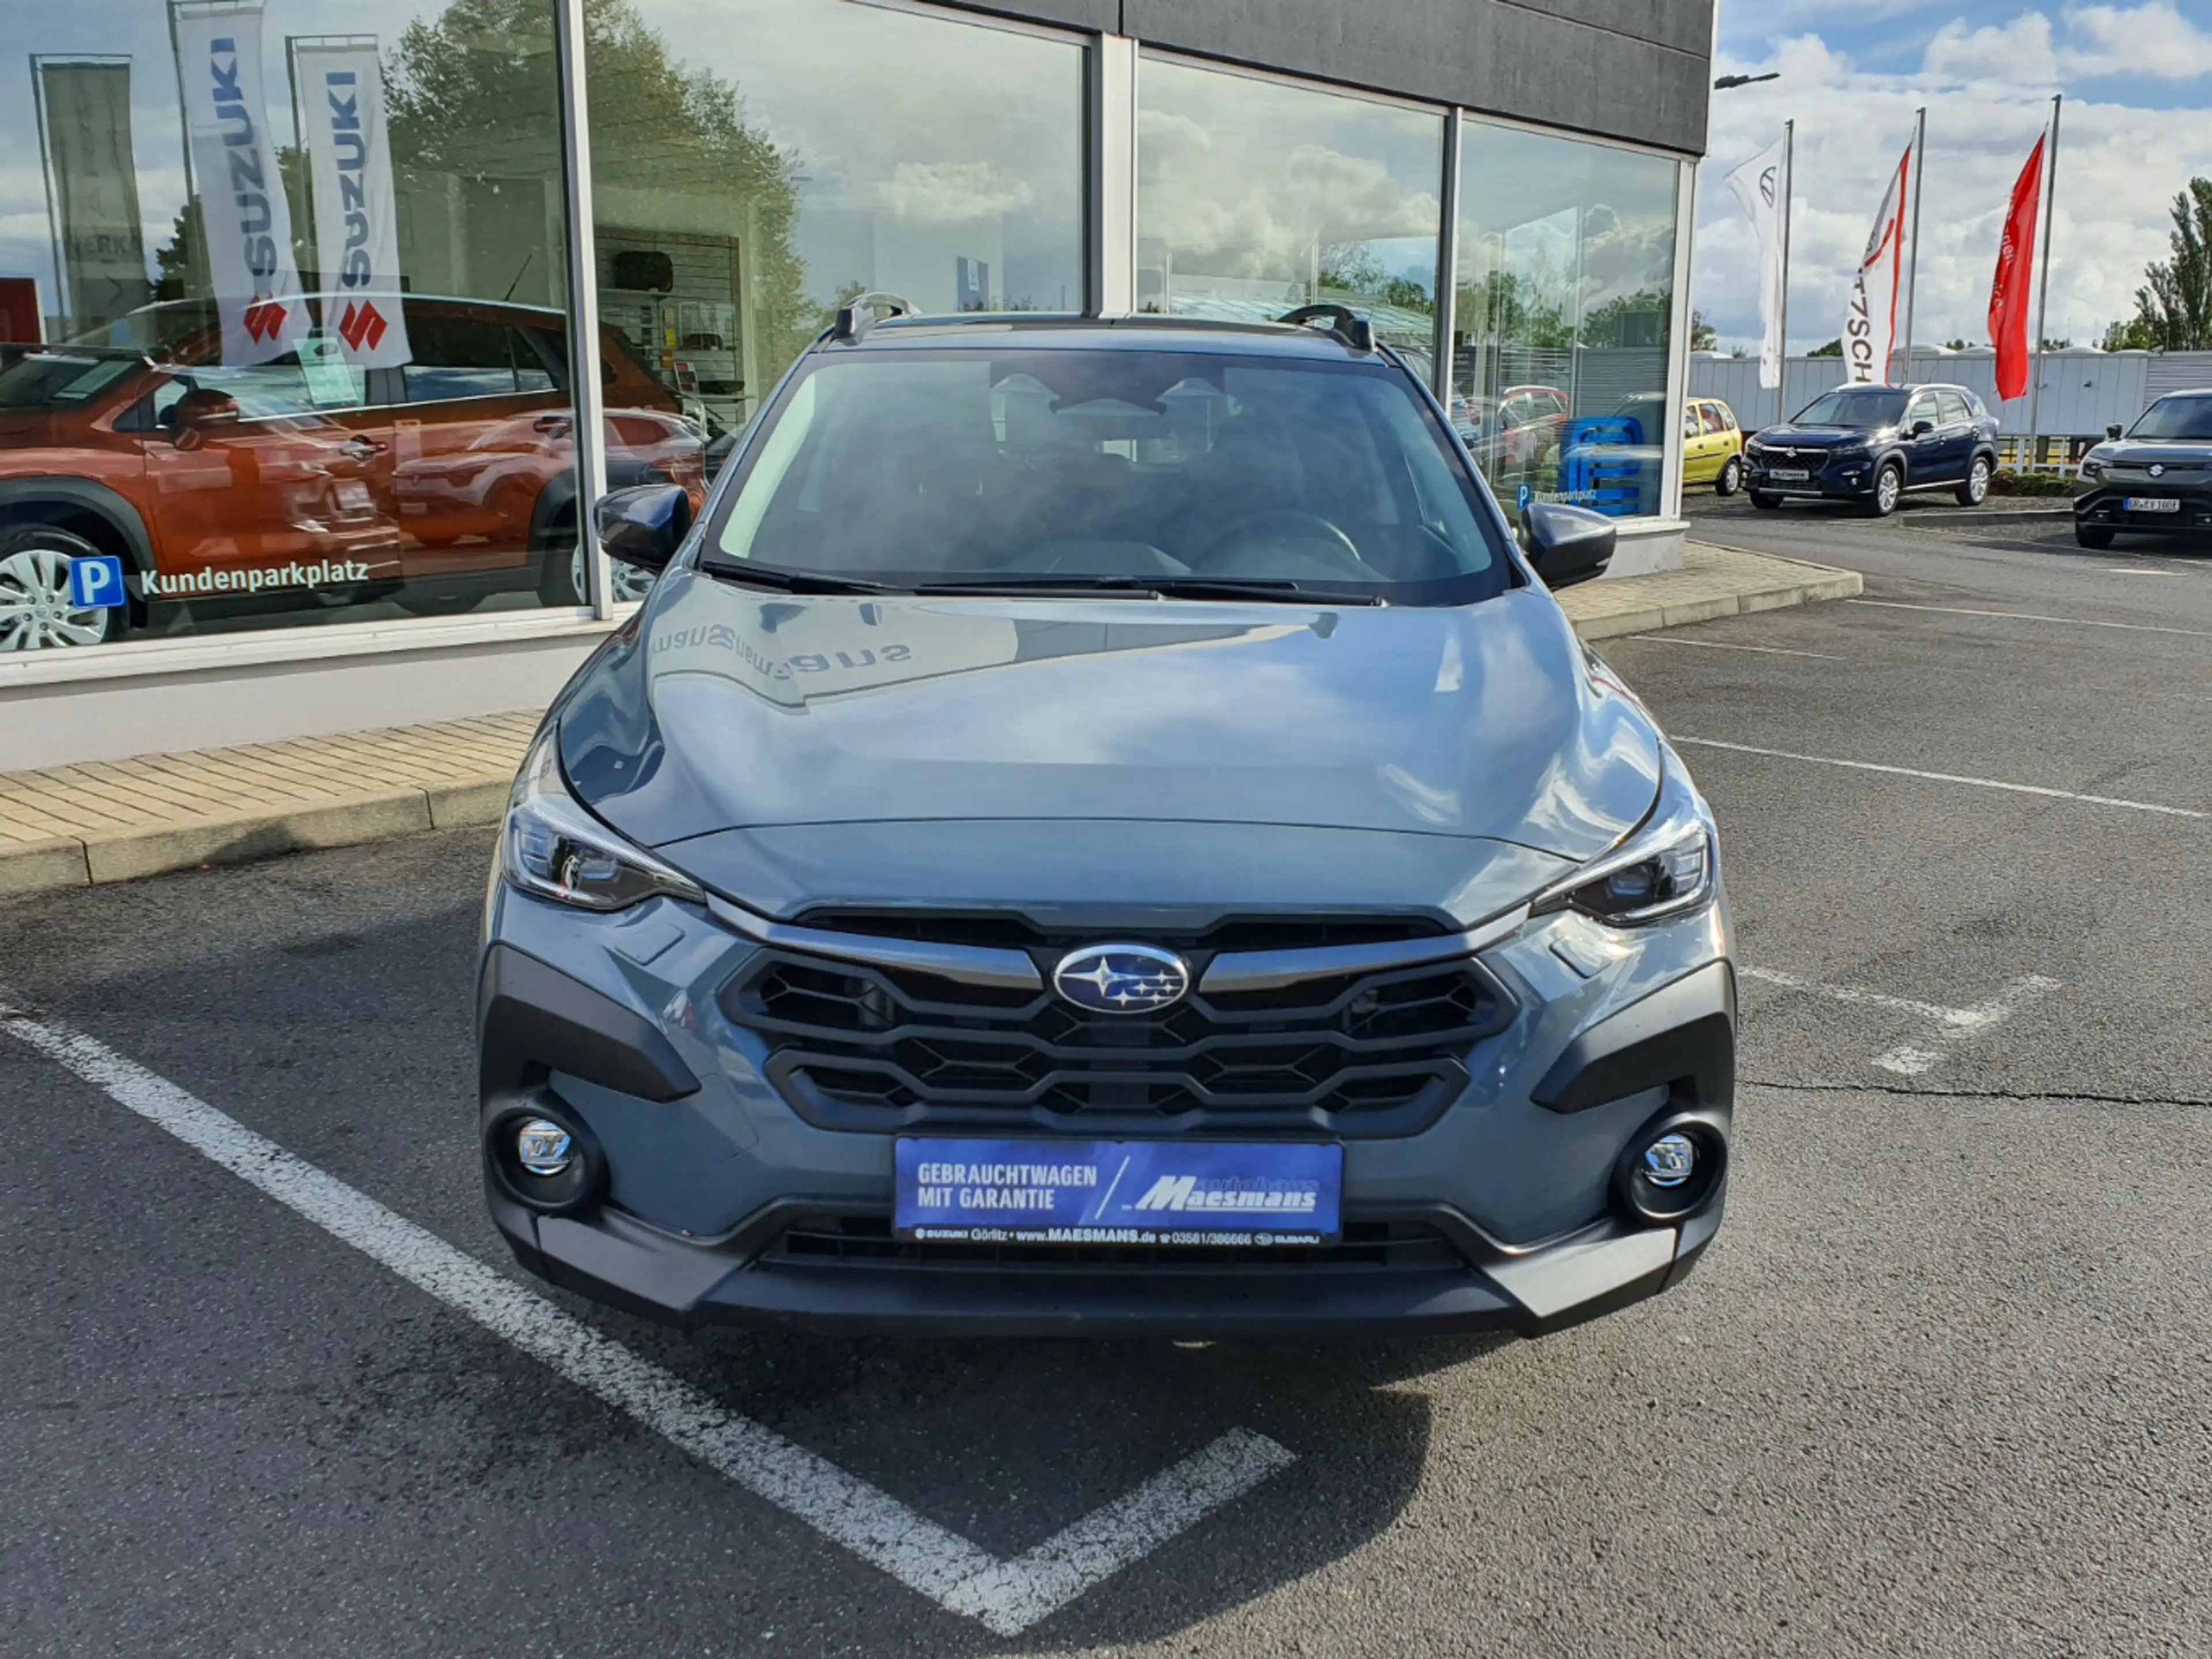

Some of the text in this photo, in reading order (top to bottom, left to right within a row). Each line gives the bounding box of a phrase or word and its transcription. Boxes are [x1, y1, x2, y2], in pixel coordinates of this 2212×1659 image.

[210, 36, 277, 278] SUZUKI
[326, 71, 372, 287] SUZUKI
[79, 560, 111, 603] P
[140, 559, 369, 594] Kundenparkplatz
[918, 1162, 1098, 1187] GEBRAUCHTWAGEN
[918, 1187, 1055, 1210] MIT GARANTIE
[1135, 1175, 1317, 1211] Maesmans
[970, 1228, 1008, 1240] Görlitz
[1016, 1228, 1156, 1243] www.MAESMANS.de
